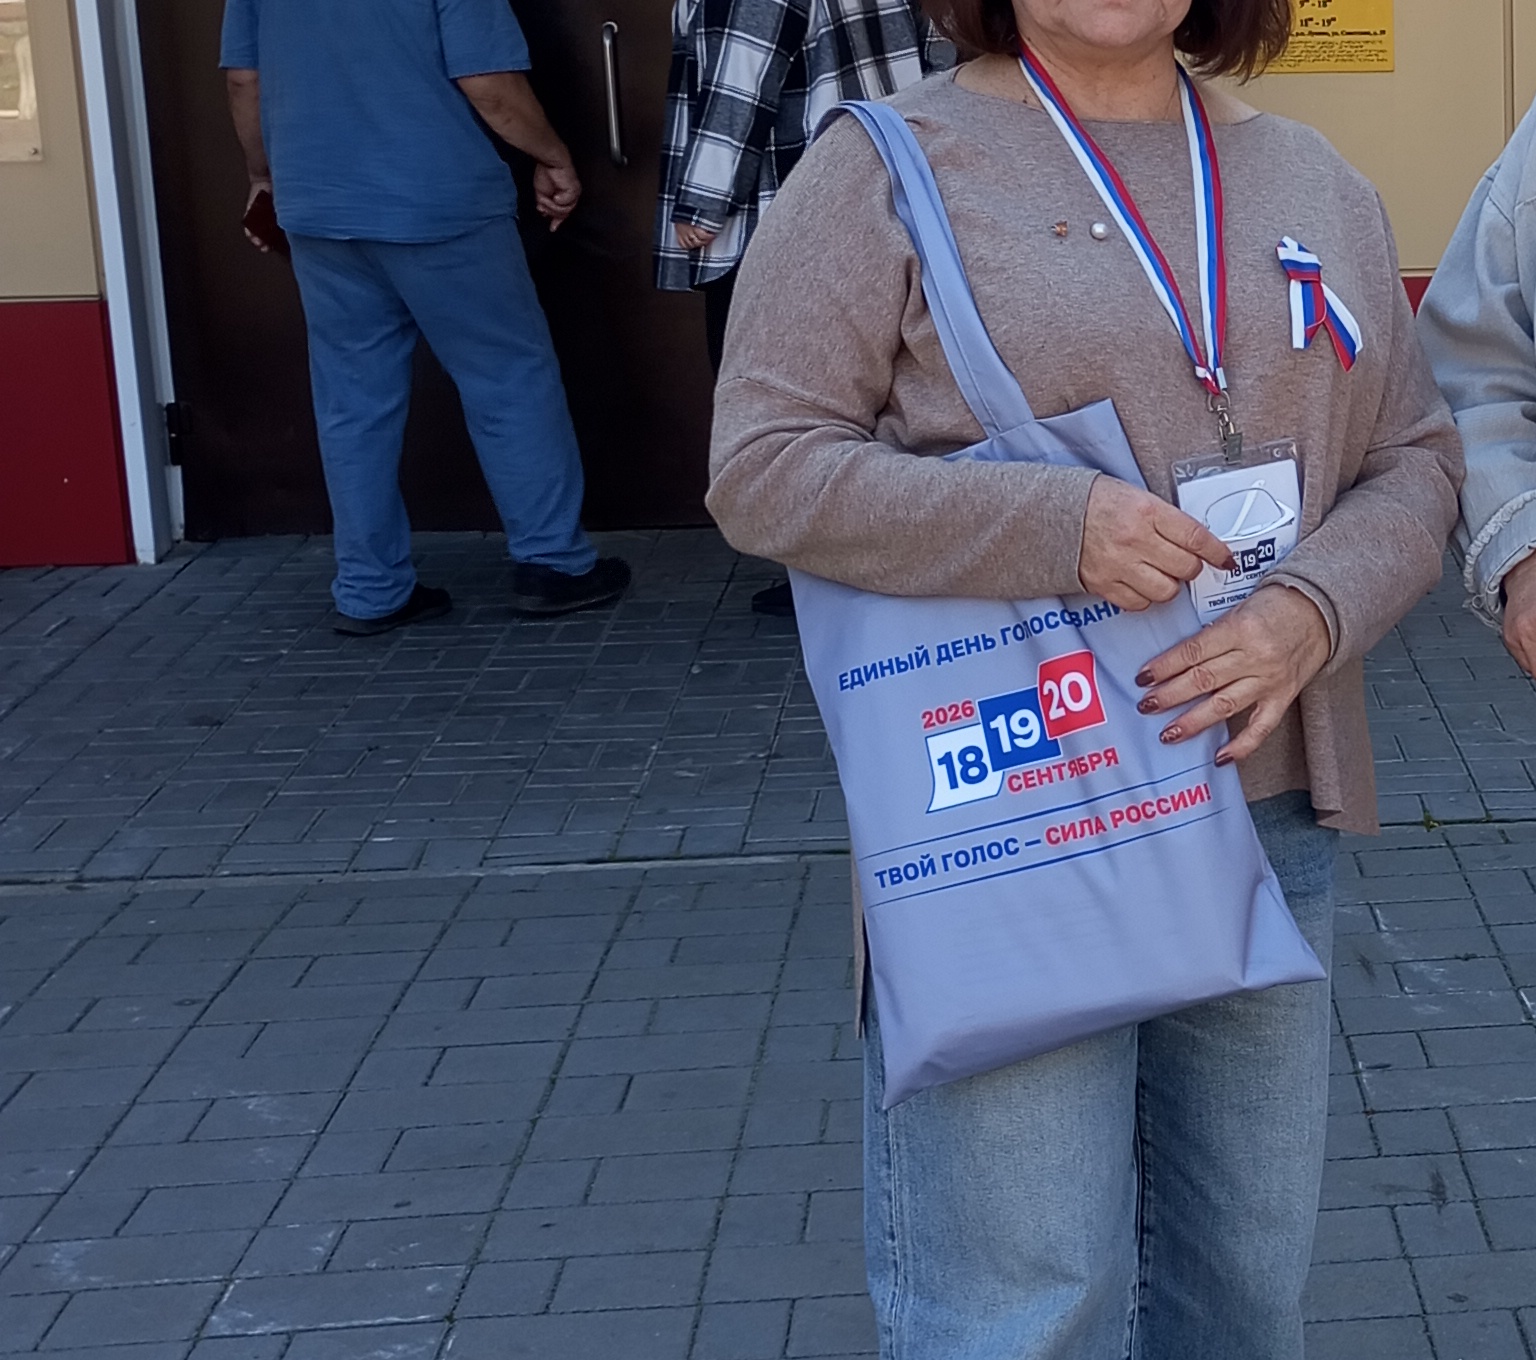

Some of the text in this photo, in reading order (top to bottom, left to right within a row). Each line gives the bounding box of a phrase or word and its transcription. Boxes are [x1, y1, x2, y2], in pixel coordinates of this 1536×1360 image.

[1244, 554, 1256, 568] 19
[1257, 544, 1274, 559] 20
[838, 600, 1127, 691] ЕДИНЫЙ ДЕНЬ ГОЛОСОВАНИ
[921, 700, 975, 730] 2026
[1043, 672, 1092, 720] 20
[990, 709, 1040, 754] 19
[937, 745, 988, 790] 18
[1007, 746, 1120, 793] СЕНТЯБРЯ
[874, 854, 937, 889] ТВОЙ
[942, 838, 1020, 872] ГОЛОС
[1045, 816, 1108, 846] СИЛА
[1109, 782, 1212, 829] РОССИИ!
